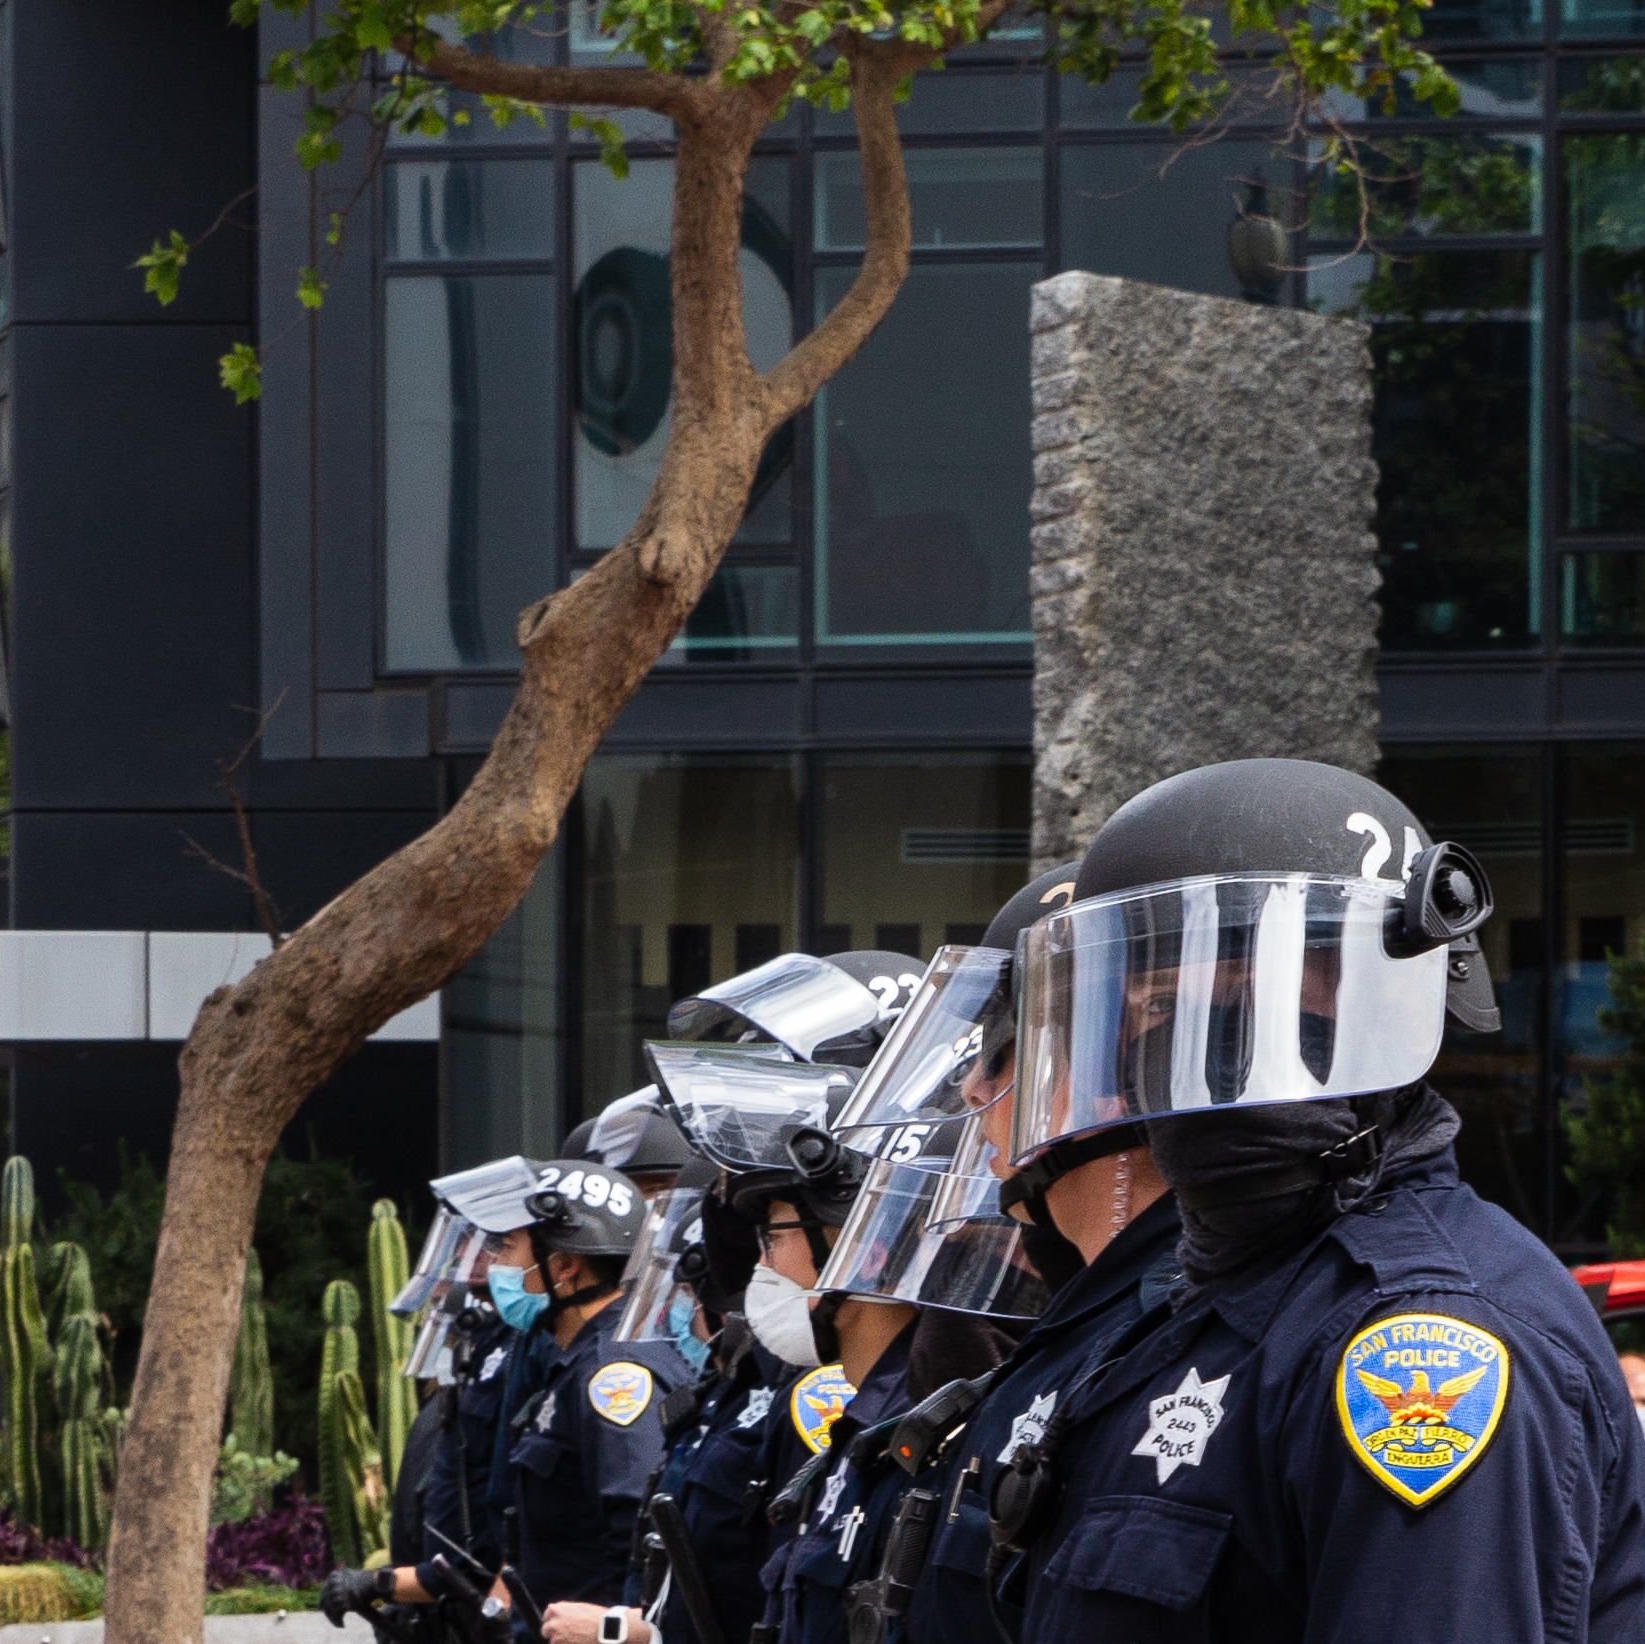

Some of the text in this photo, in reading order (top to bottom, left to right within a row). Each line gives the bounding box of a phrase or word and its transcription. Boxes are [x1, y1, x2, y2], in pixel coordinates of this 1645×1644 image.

[535, 1167, 634, 1217] 2495
[1350, 1323, 1499, 1367] SAN FRANCISCO
[1384, 1349, 1461, 1369] POLICE
[1151, 1433, 1197, 1458] POLICE
